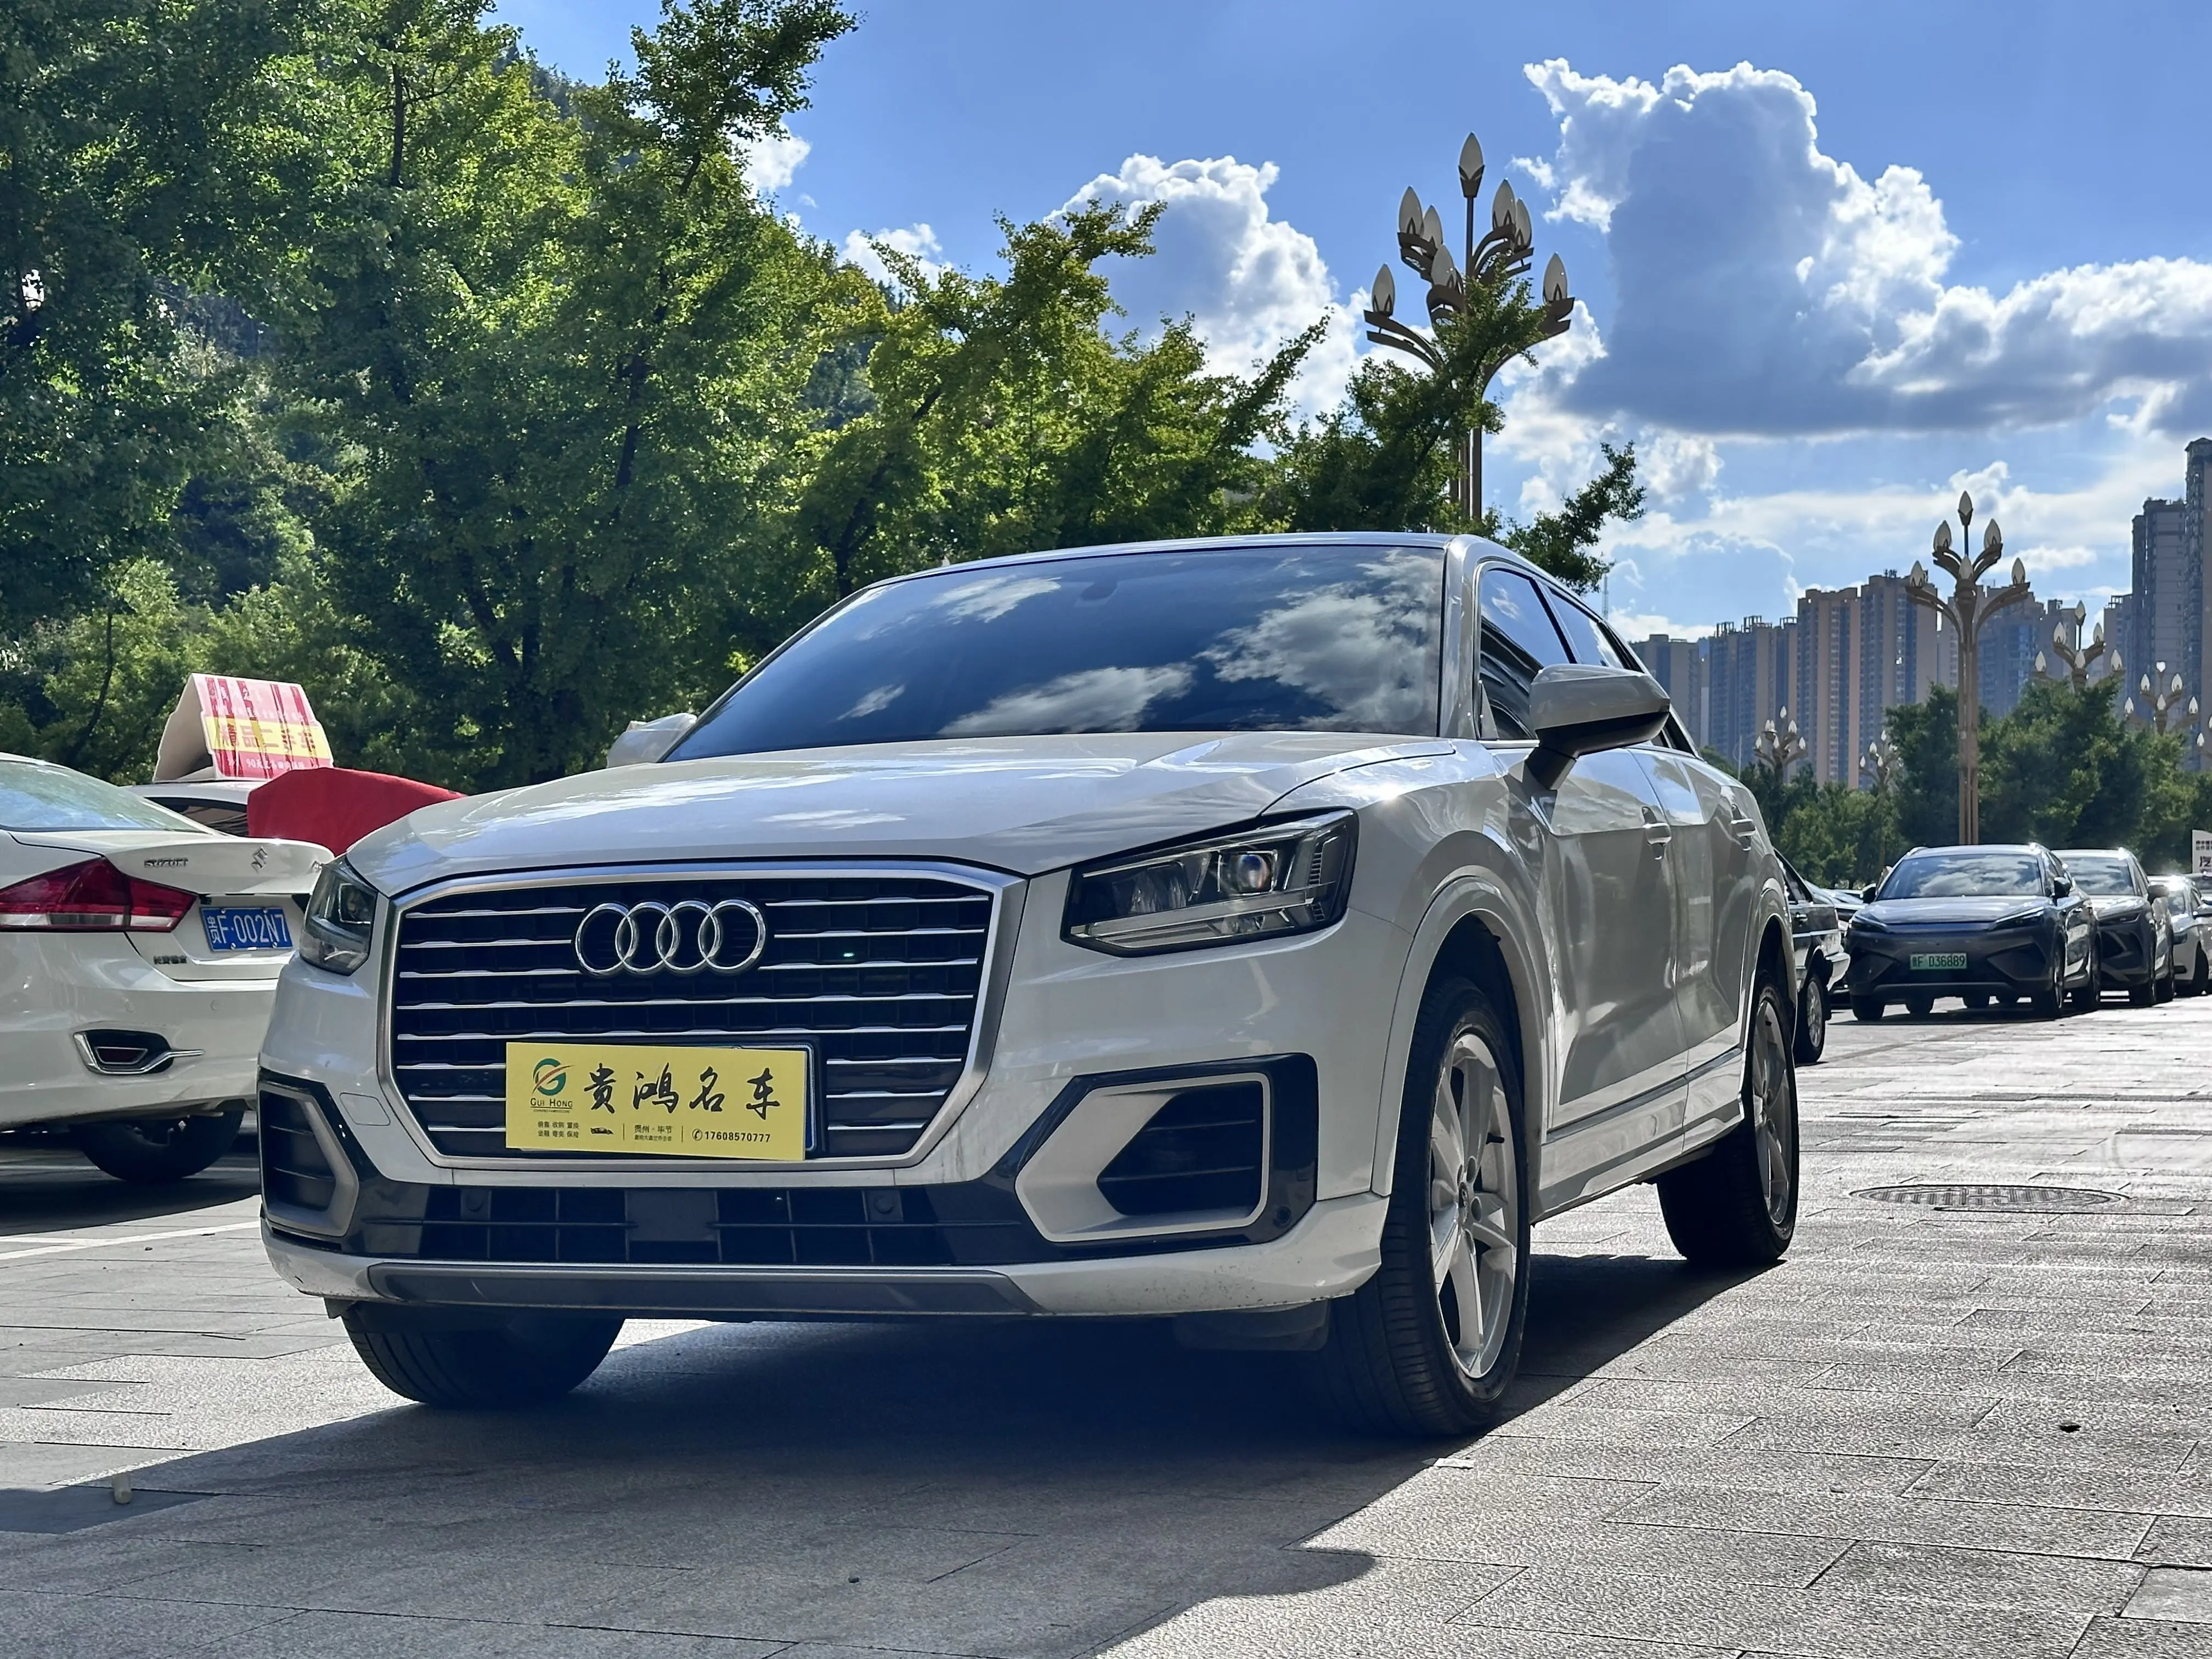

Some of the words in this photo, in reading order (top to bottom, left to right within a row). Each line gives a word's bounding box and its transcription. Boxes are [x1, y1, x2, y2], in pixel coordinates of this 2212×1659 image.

[584, 1063, 780, 1120] 贵鸿名车
[704, 1131, 770, 1143] 17608570777
